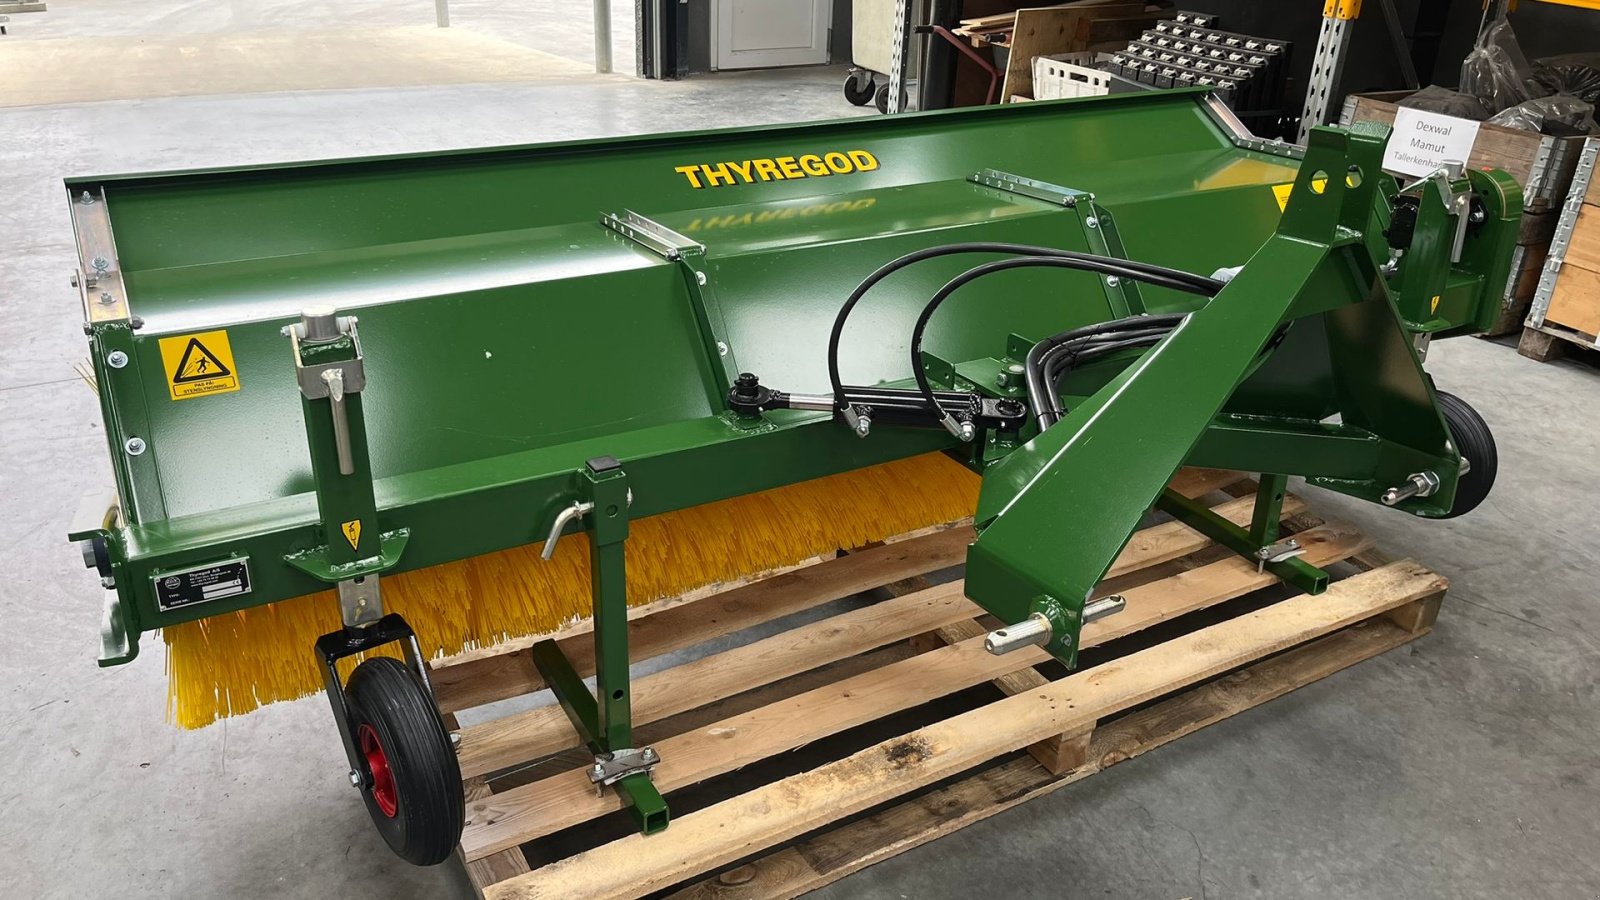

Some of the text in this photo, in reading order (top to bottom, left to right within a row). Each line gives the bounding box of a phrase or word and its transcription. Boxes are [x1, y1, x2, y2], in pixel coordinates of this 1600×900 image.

[1416, 120, 1453, 136] Dexwal
[1410, 137, 1446, 154] Mamut
[1394, 151, 1441, 169] Tallerkenhar
[674, 149, 880, 189] THYREGOD
